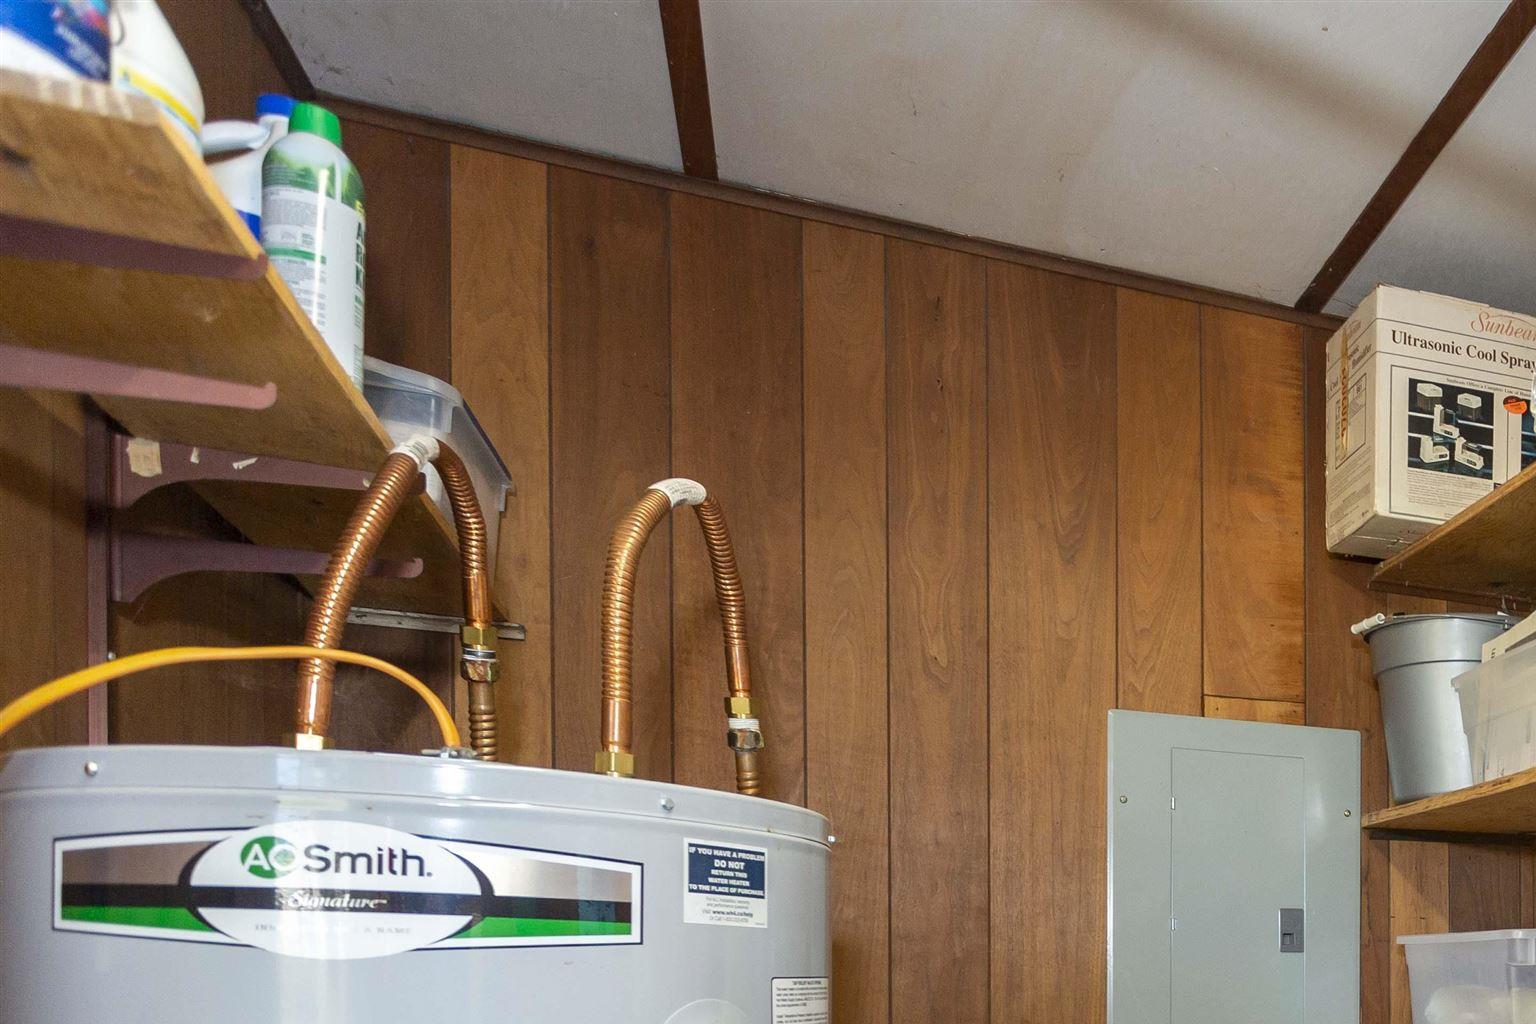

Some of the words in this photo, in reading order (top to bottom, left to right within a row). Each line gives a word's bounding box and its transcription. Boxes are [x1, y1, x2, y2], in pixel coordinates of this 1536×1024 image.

[1391, 328, 1463, 357] Ultrasonic
[1466, 344, 1497, 362] Cool
[698, 847, 712, 855] YOU
[713, 850, 731, 858] HAVE
[714, 859, 727, 868] DO
[728, 861, 745, 869] NOT
[287, 887, 388, 910] Signature
